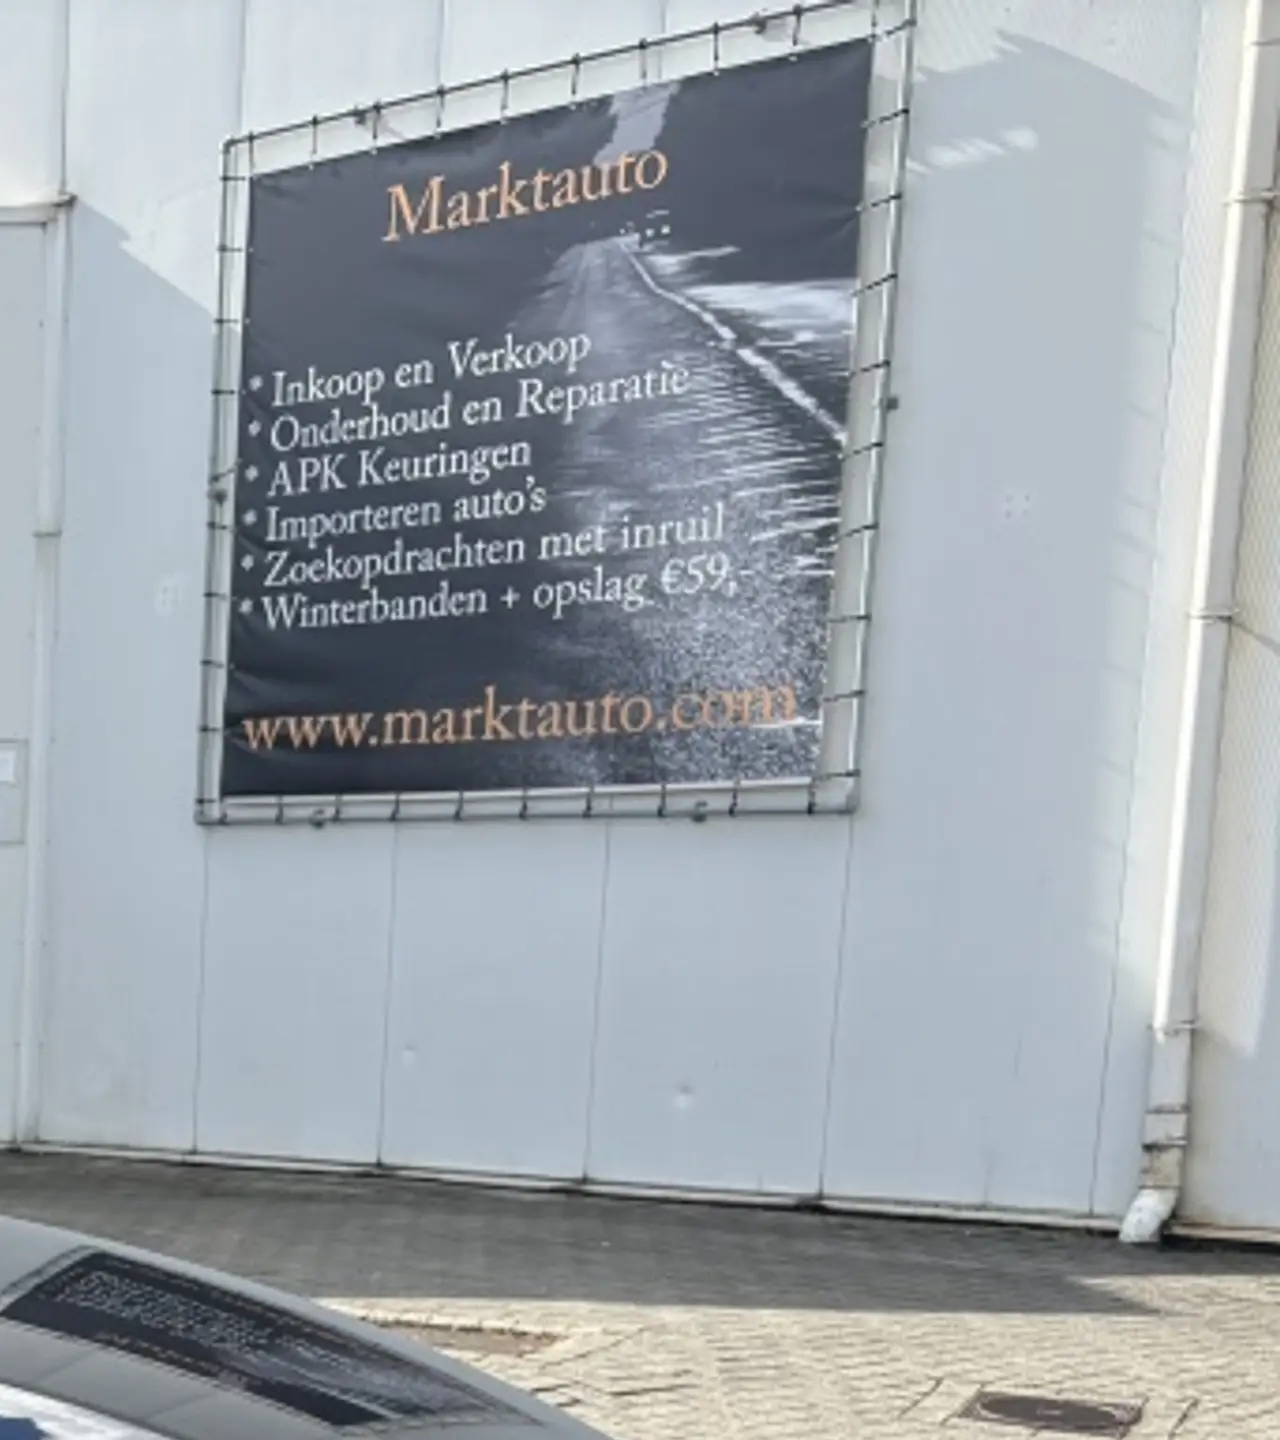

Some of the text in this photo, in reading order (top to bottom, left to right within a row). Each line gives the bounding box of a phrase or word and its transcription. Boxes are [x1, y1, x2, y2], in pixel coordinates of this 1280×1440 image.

[381, 150, 669, 241] Marktauto
[270, 360, 691, 452] Onderhoud en Reparatie
[271, 332, 592, 407] Inkoop en Verkoop
[266, 439, 533, 498] APK Keuringen
[262, 502, 726, 590] Zoekopdrachten met inruil
[264, 475, 547, 549] Importeren auto's
[262, 582, 488, 632] Winterbanden
[532, 565, 649, 620] opslag
[242, 684, 797, 751] www.marktauto.com
